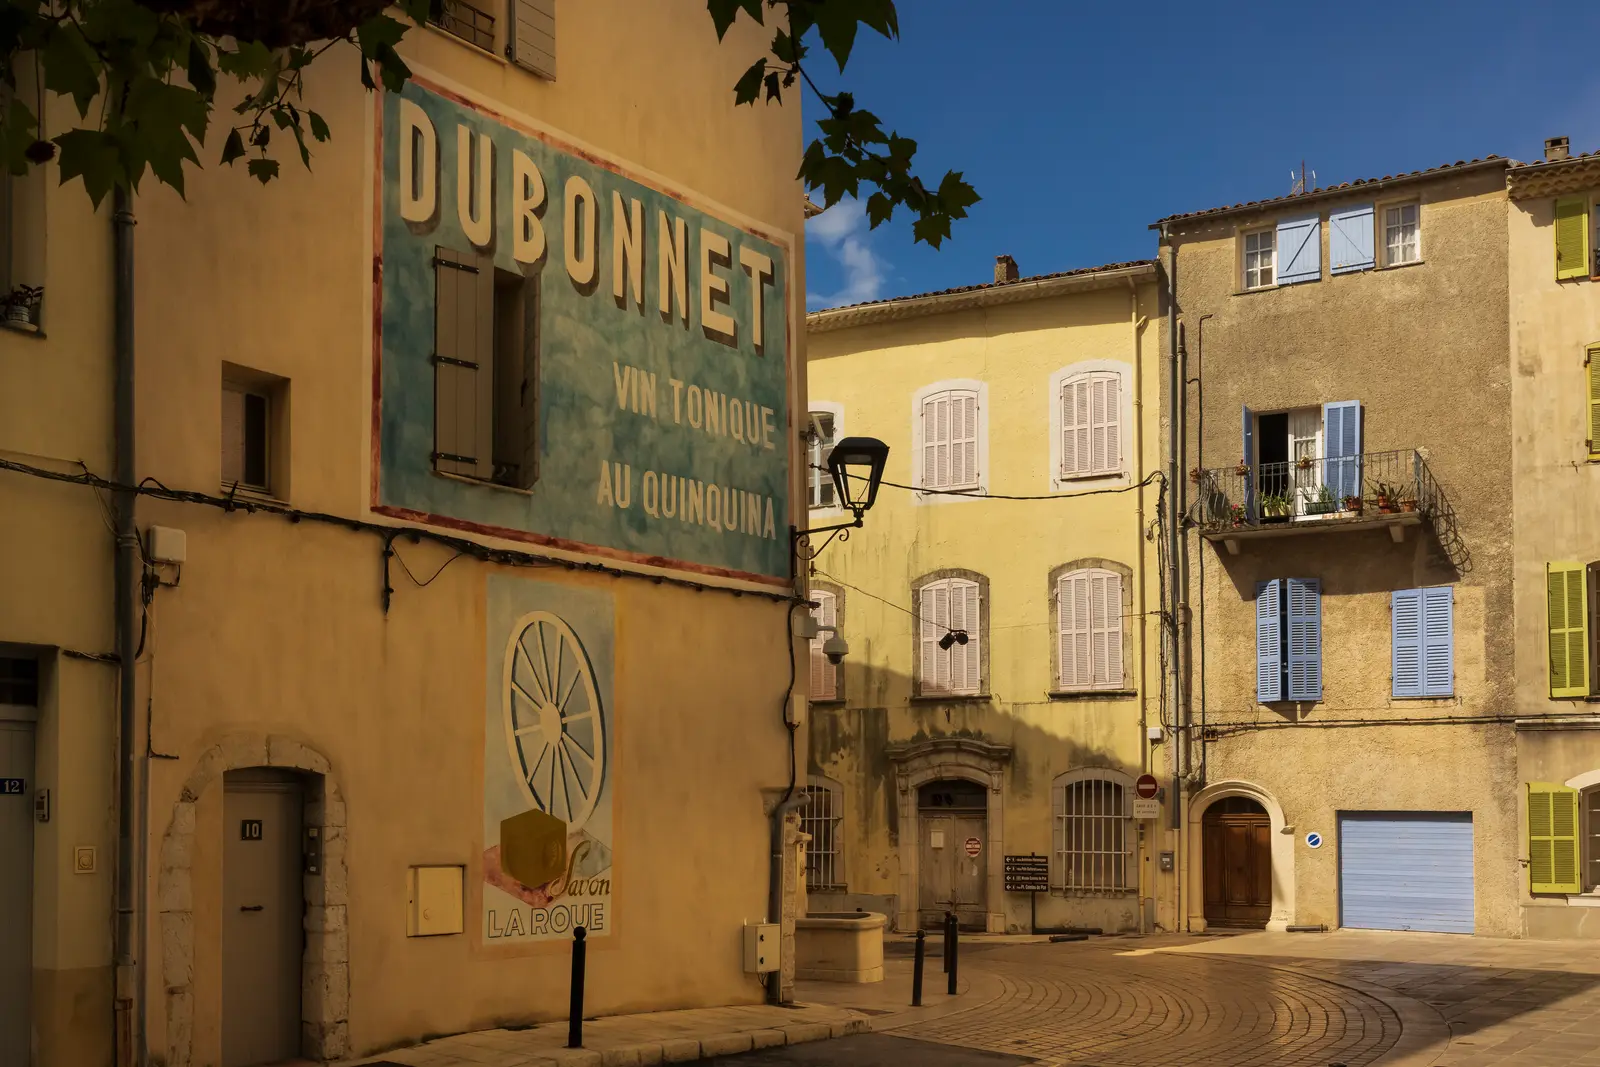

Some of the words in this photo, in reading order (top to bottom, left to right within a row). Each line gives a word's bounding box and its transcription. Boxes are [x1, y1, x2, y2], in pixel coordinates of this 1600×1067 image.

[401, 97, 775, 349] DUBONNET
[613, 361, 657, 418] VIN
[669, 378, 776, 450] TONIQUE
[597, 460, 632, 509] AU
[643, 471, 777, 540] QUINQUINA
[4, 780, 20, 793] 12
[246, 823, 260, 837] 10
[550, 840, 610, 897] Savon
[488, 908, 525, 938] LA
[531, 903, 604, 935] ROUE
